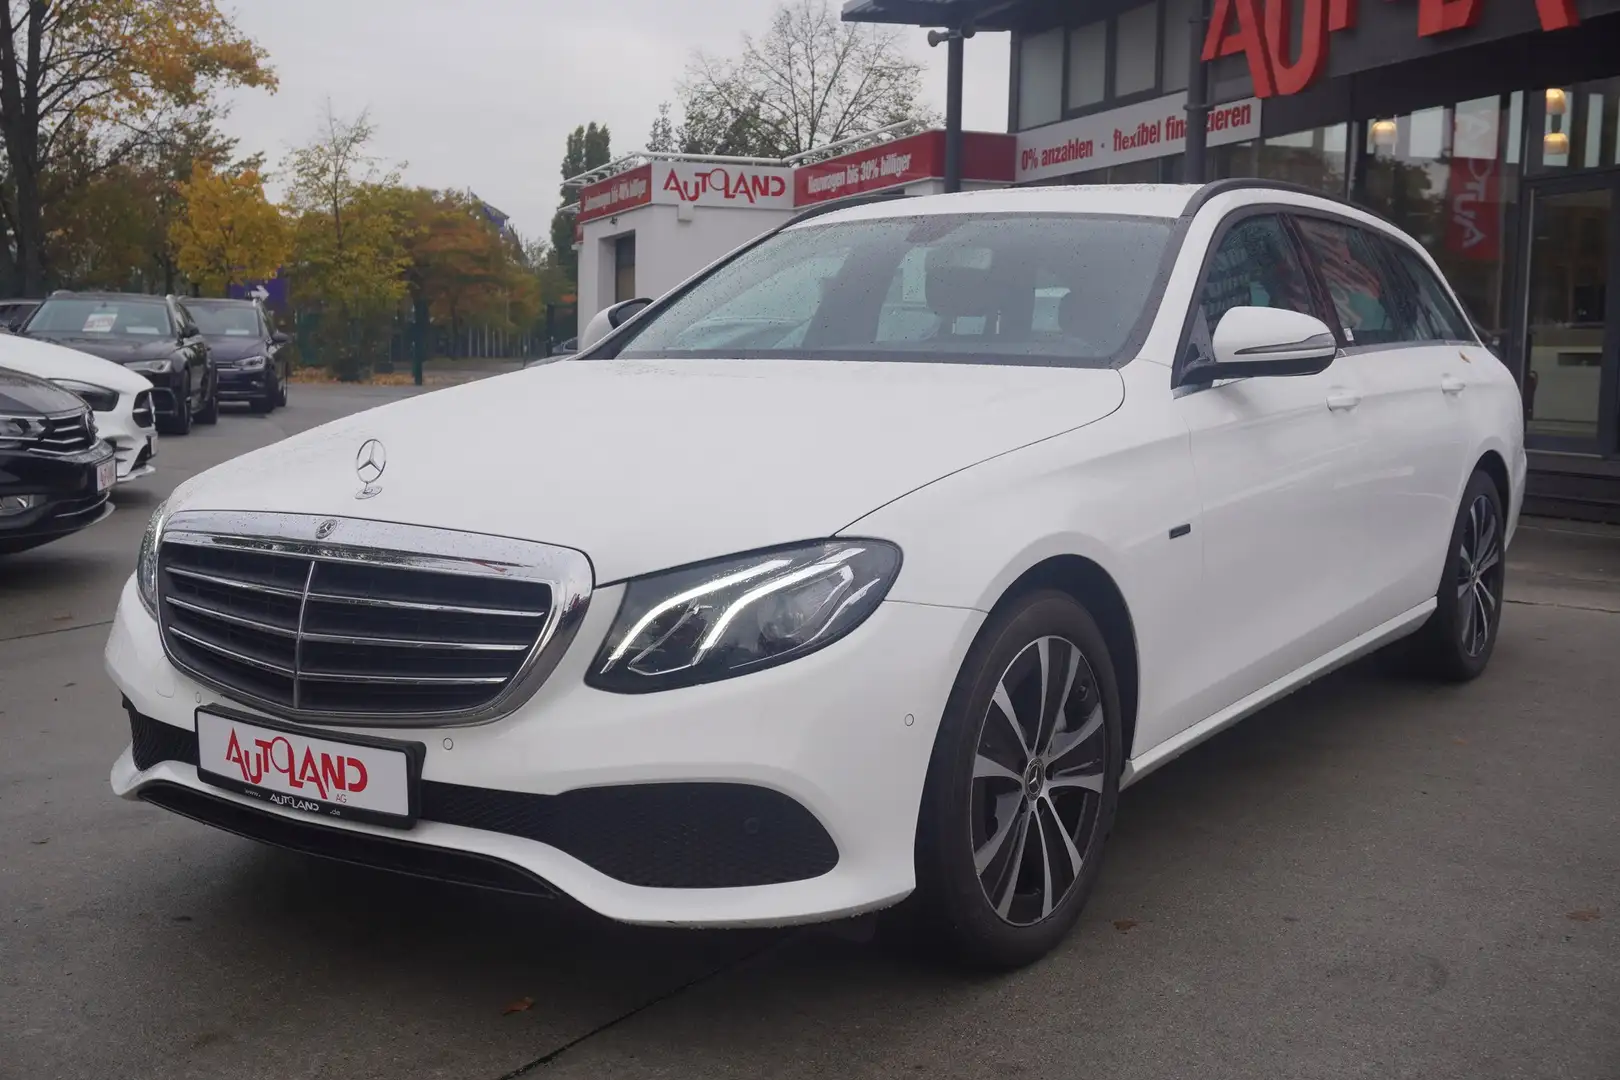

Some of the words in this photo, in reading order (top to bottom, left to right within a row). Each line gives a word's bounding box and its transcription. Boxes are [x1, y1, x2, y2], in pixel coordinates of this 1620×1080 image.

[1021, 147, 1039, 171] 0%
[1041, 137, 1094, 167] anzahlen
[1113, 119, 1162, 152] flexibel
[663, 168, 786, 204] AUTOLAND
[226, 727, 368, 800] AUTOLAND
[335, 793, 348, 804] AG
